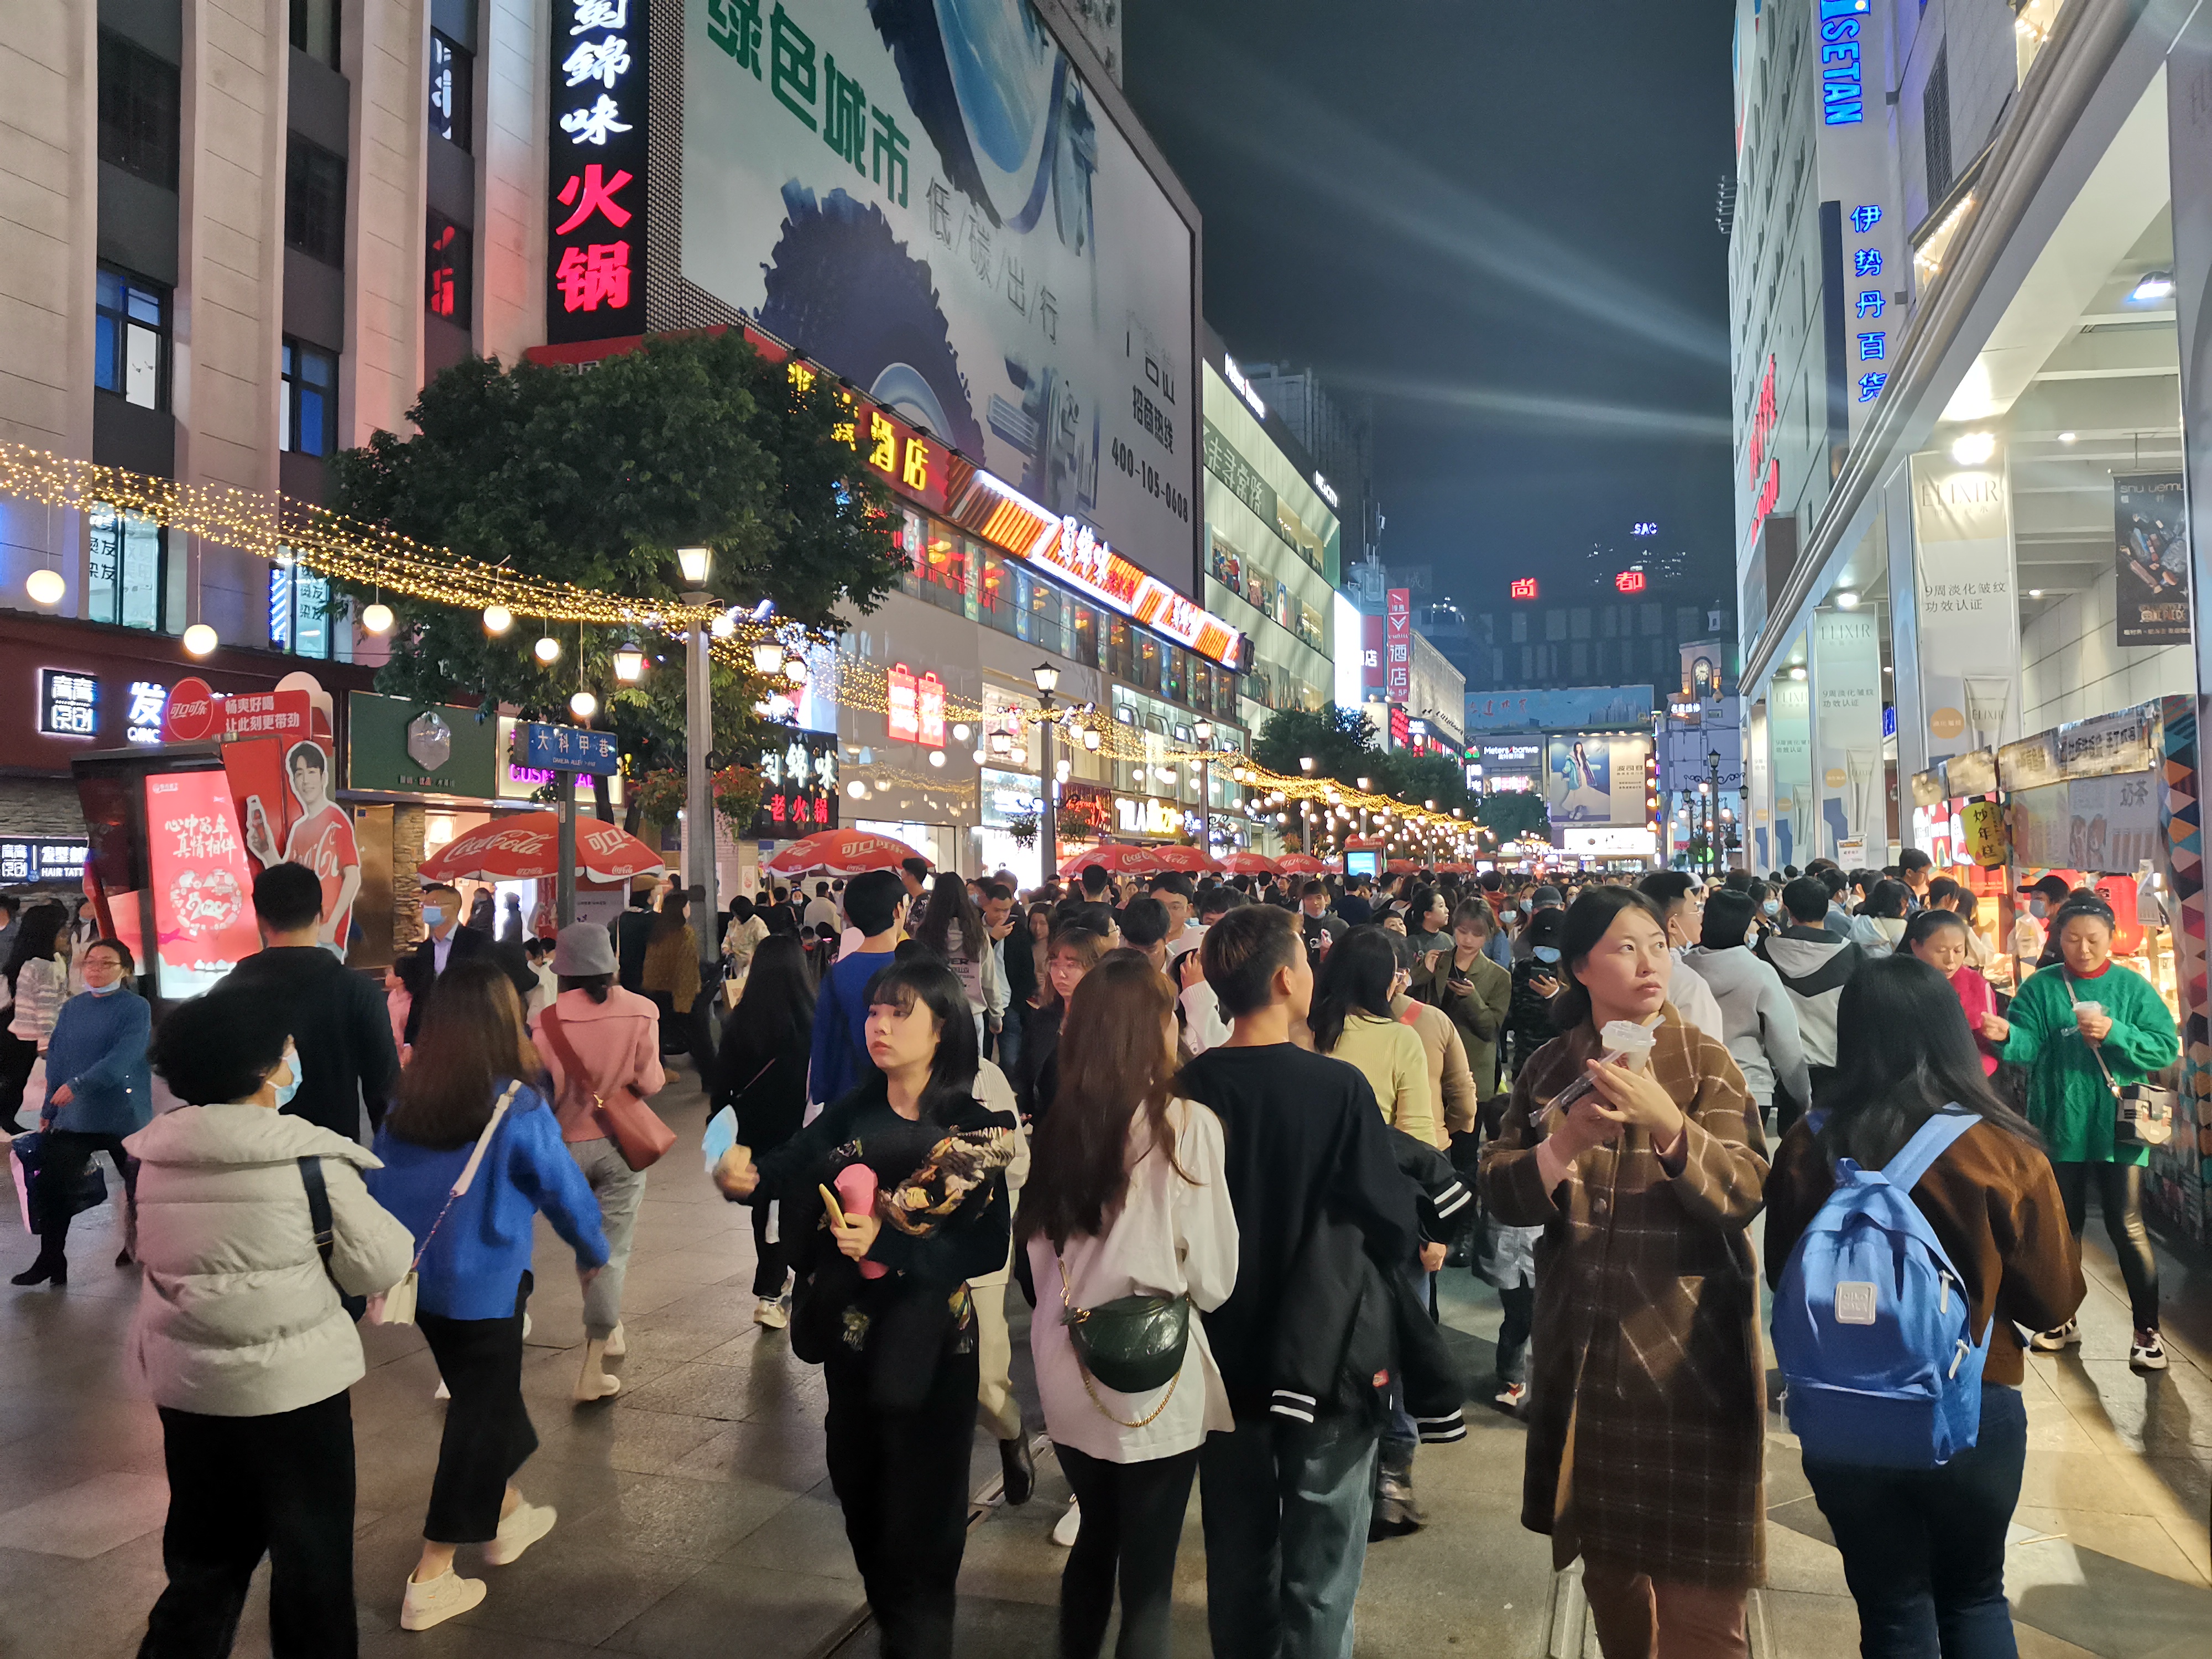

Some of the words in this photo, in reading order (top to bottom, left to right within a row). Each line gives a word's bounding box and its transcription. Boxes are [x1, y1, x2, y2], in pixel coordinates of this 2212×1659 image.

[707, 0, 910, 209] 绿色城市
[555, 164, 633, 312] 火锅
[1850, 204, 1887, 403] 伊势丹百货
[1133, 384, 1173, 455] 招商热线
[1112, 436, 1188, 524] 400-105-0608
[1922, 479, 1999, 507] ELIXIR
[1925, 581, 2007, 597] 9周淡化皱纹
[1926, 598, 1983, 613] 功效认证
[1390, 644, 1407, 686] 酒店
[225, 695, 275, 716] 畅爽好喝
[225, 712, 300, 733] 让此刻更带劲
[537, 729, 609, 758] 大科甲巷
[771, 793, 828, 823] 老火锅
[41, 867, 63, 877] HAIR
[64, 867, 85, 877] TATT
